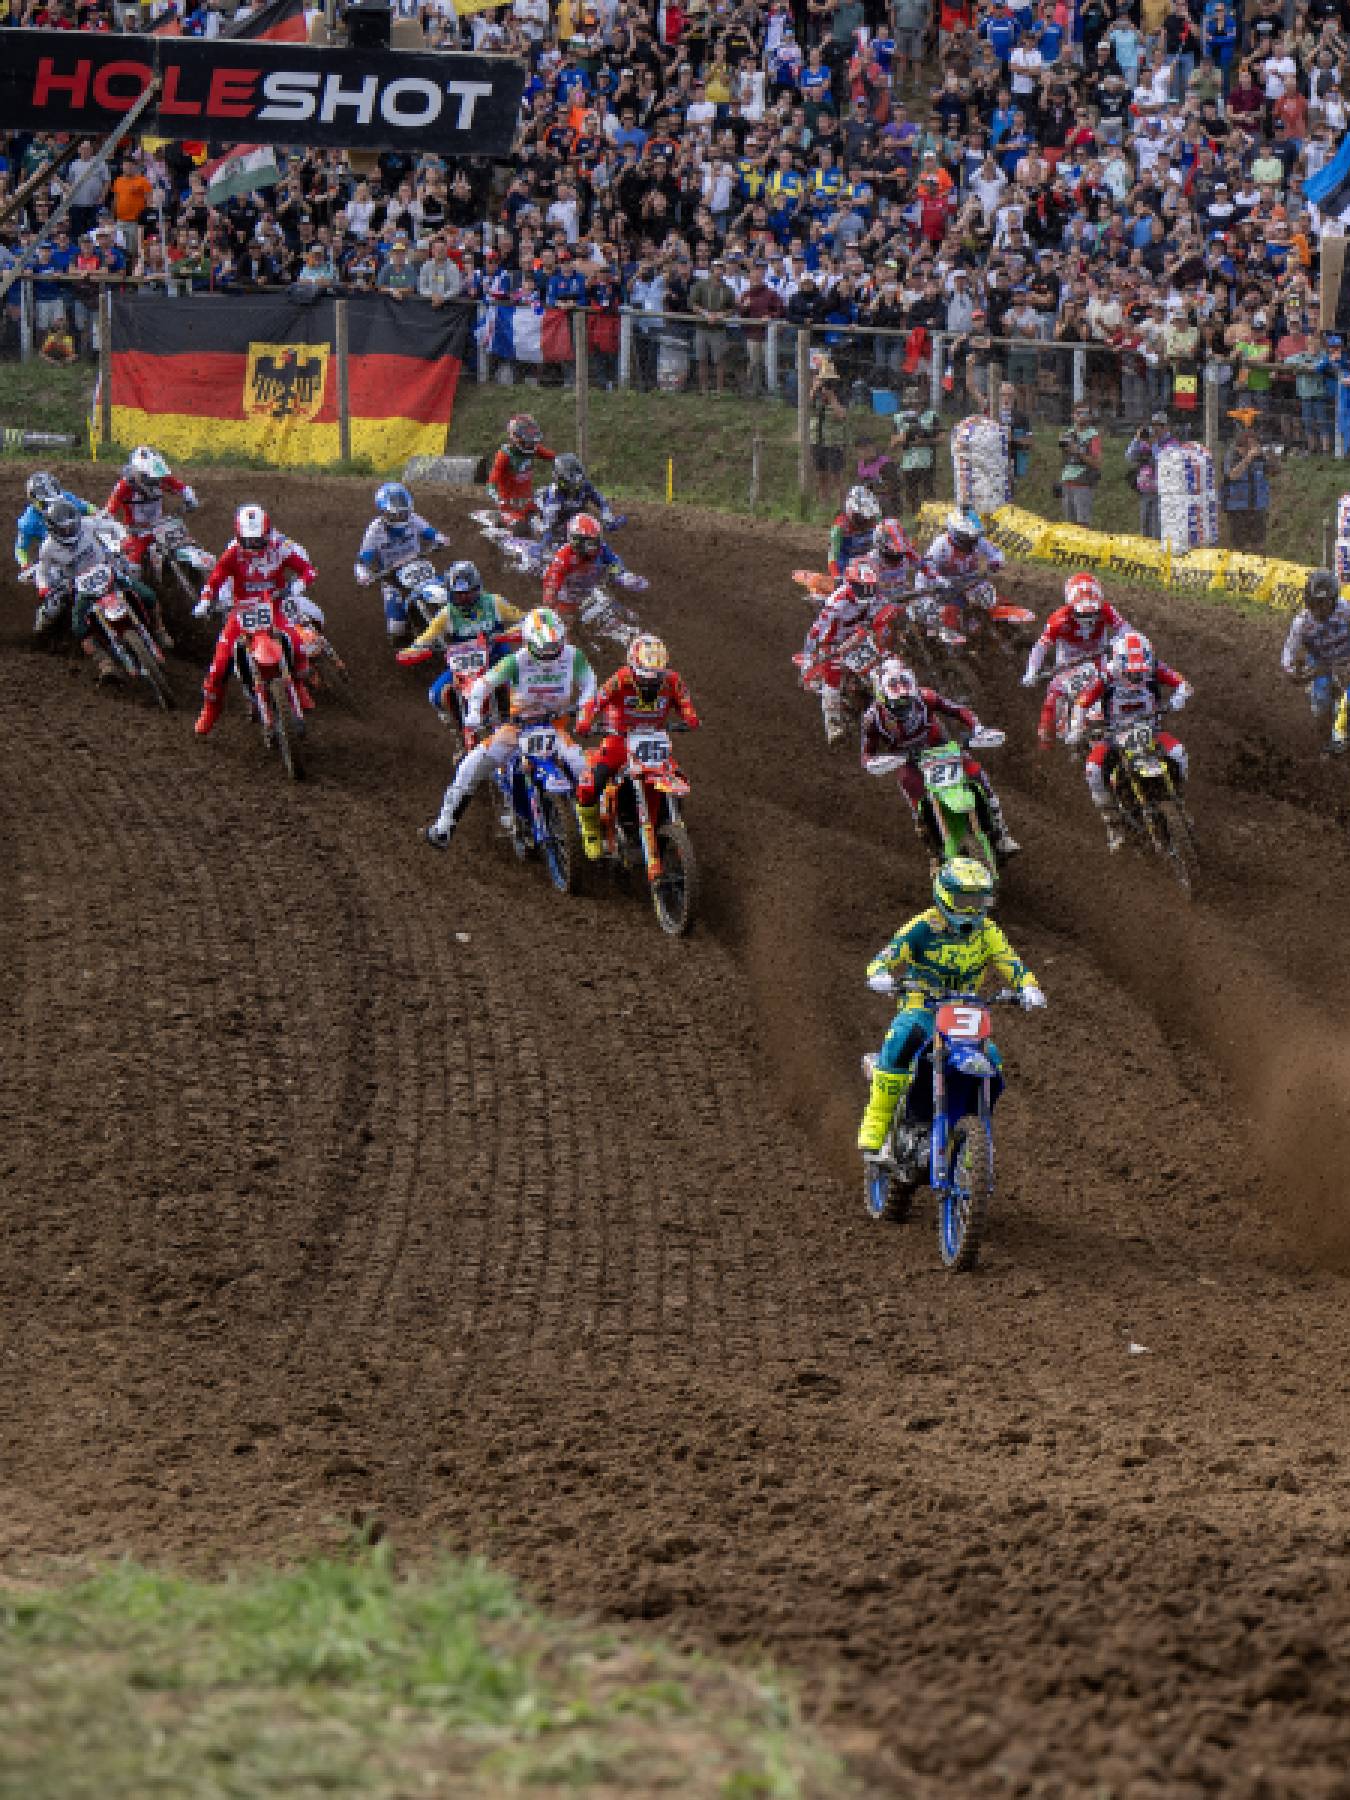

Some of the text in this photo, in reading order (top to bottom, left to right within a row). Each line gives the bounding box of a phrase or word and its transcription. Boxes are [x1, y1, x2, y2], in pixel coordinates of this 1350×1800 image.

[32, 57, 493, 130] HOLESHOT
[636, 740, 668, 762] 45
[930, 761, 958, 784] 27
[947, 1007, 981, 1035] 3
